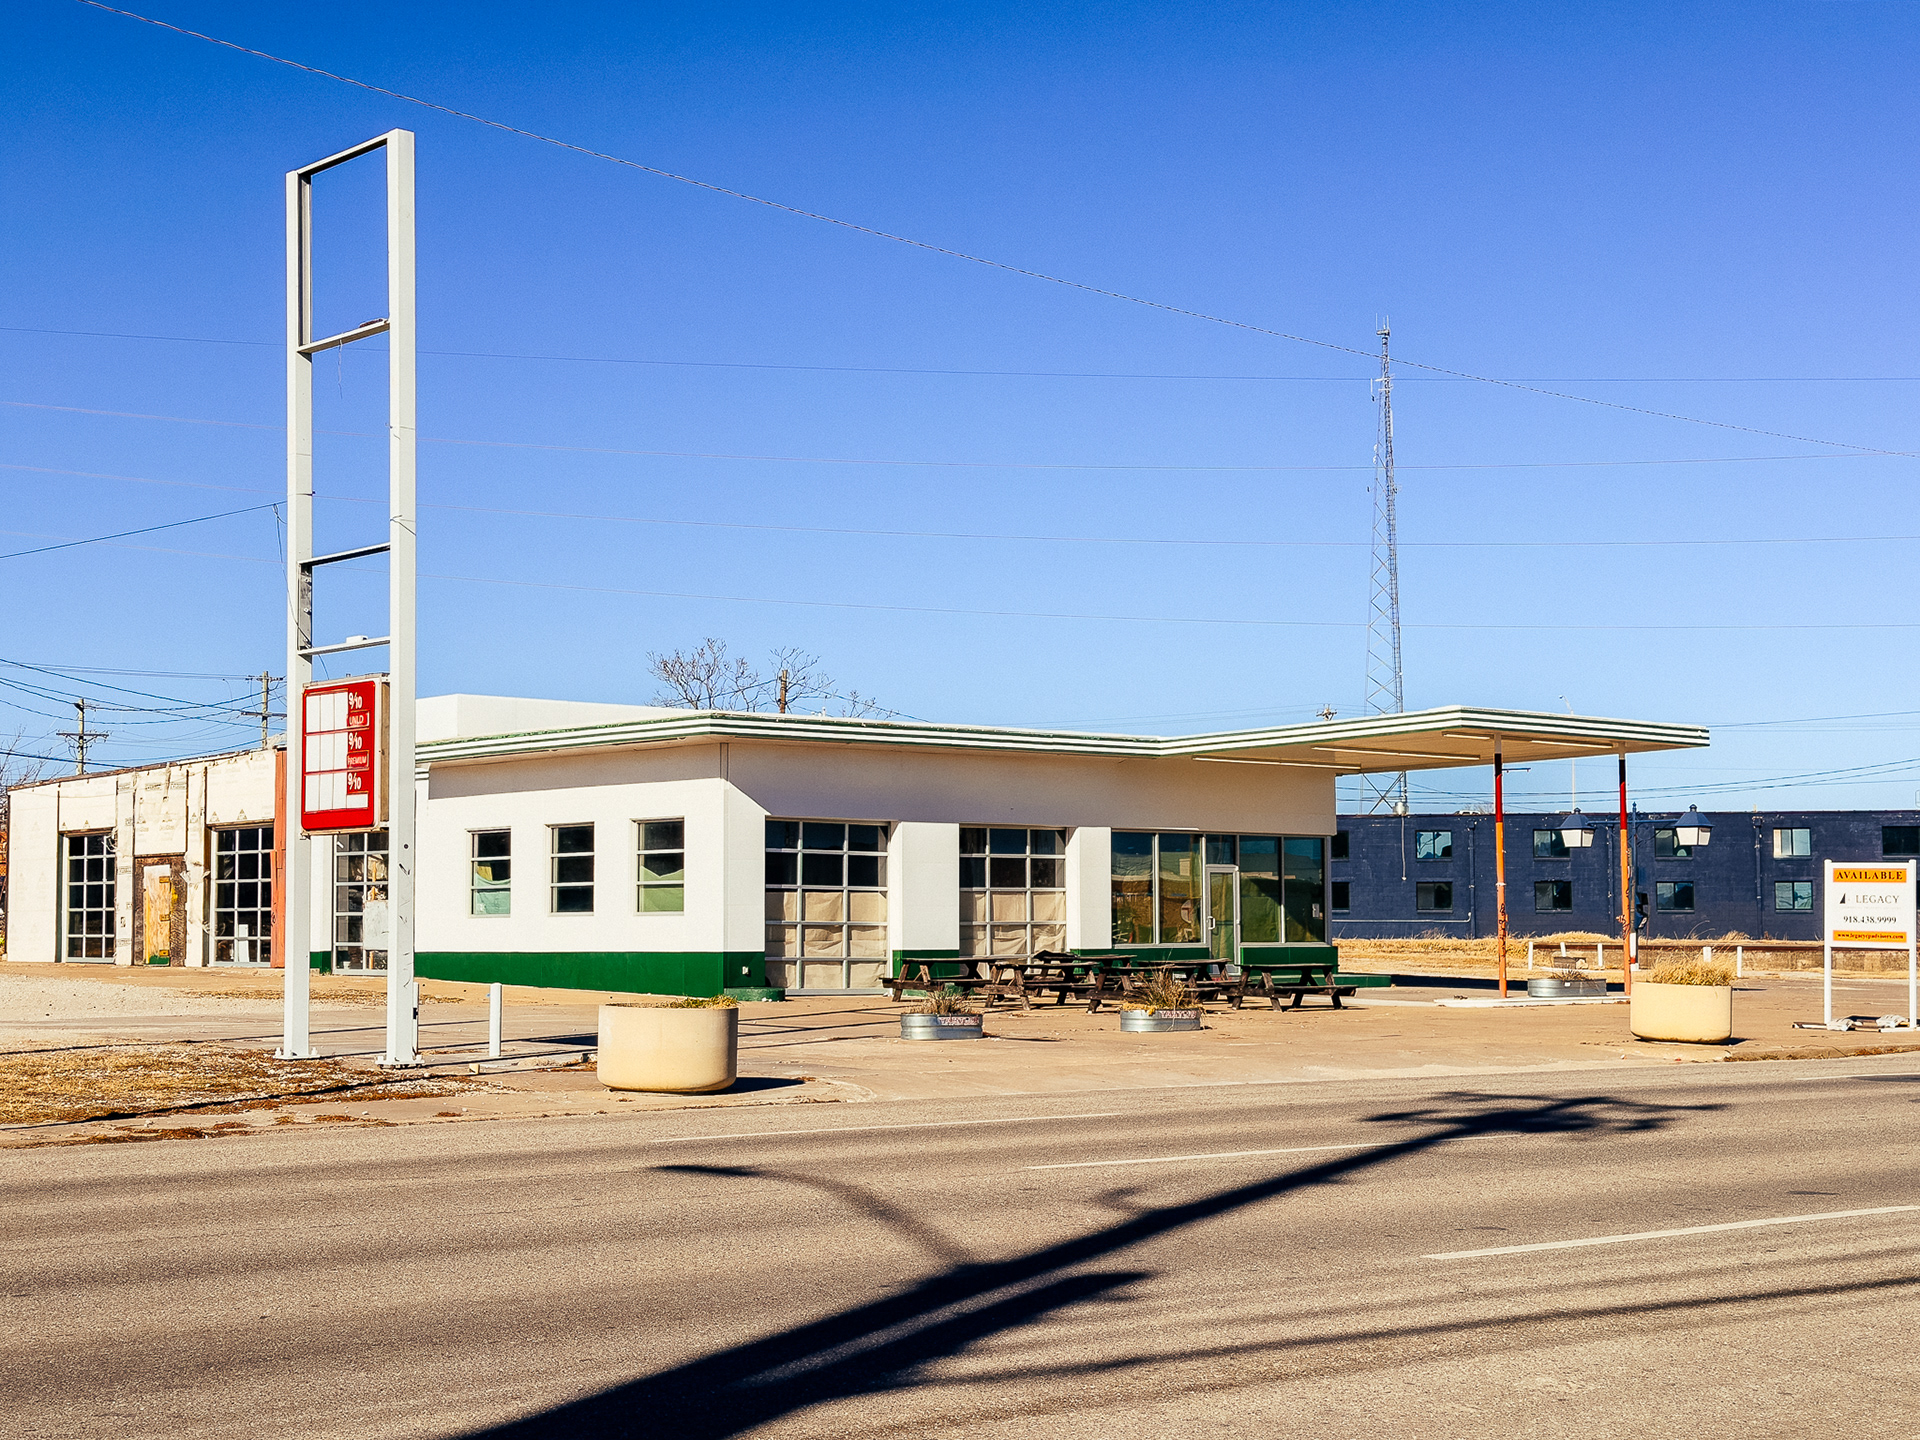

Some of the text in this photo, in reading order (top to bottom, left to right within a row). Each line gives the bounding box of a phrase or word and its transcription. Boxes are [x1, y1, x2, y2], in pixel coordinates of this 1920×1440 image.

[348, 715, 364, 725] UNLD
[347, 755, 367, 765] PREMIUM
[1836, 871, 1903, 880] AVAILABLE
[1855, 894, 1900, 904] LEGACY
[1843, 915, 1897, 924] 918.438.9999
